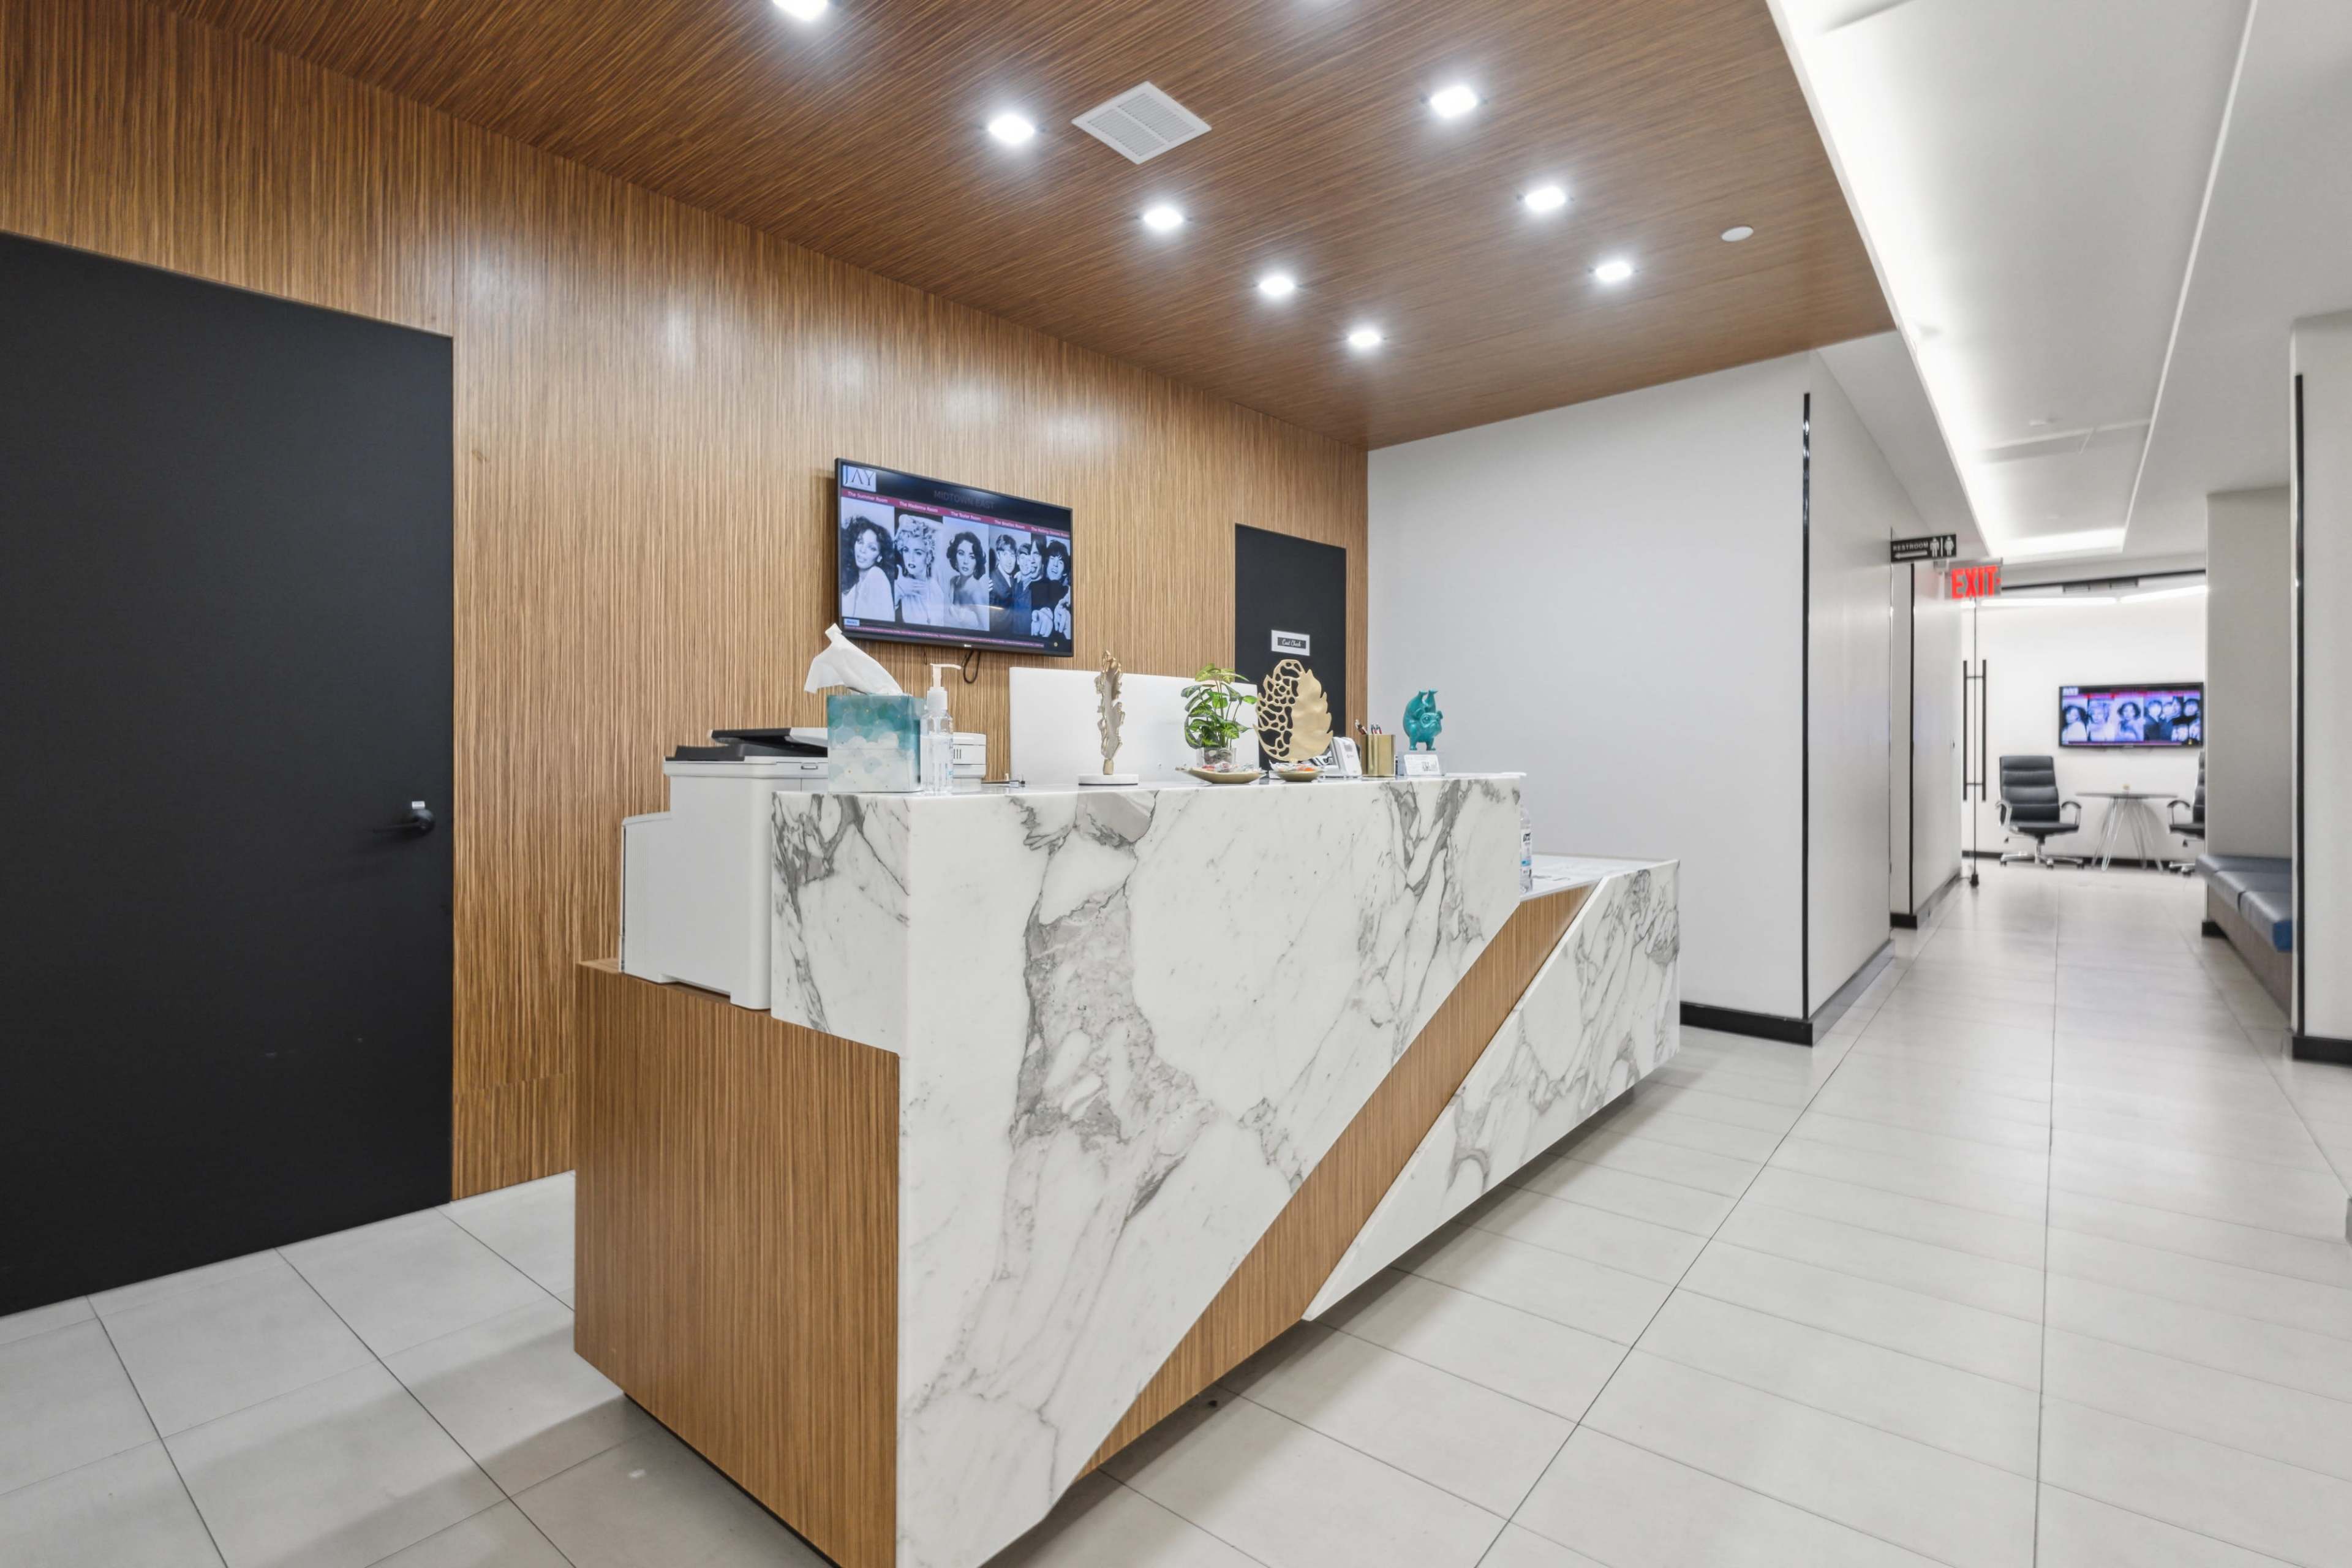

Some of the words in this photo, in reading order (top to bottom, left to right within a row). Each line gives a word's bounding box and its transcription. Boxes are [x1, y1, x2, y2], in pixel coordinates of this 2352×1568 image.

[845, 466, 875, 486] JAY
[934, 490, 974, 505] MIDTOWN
[975, 498, 995, 510] EAST
[1893, 541, 1929, 551] RESTROOM
[1951, 565, 1998, 600] EXIT
